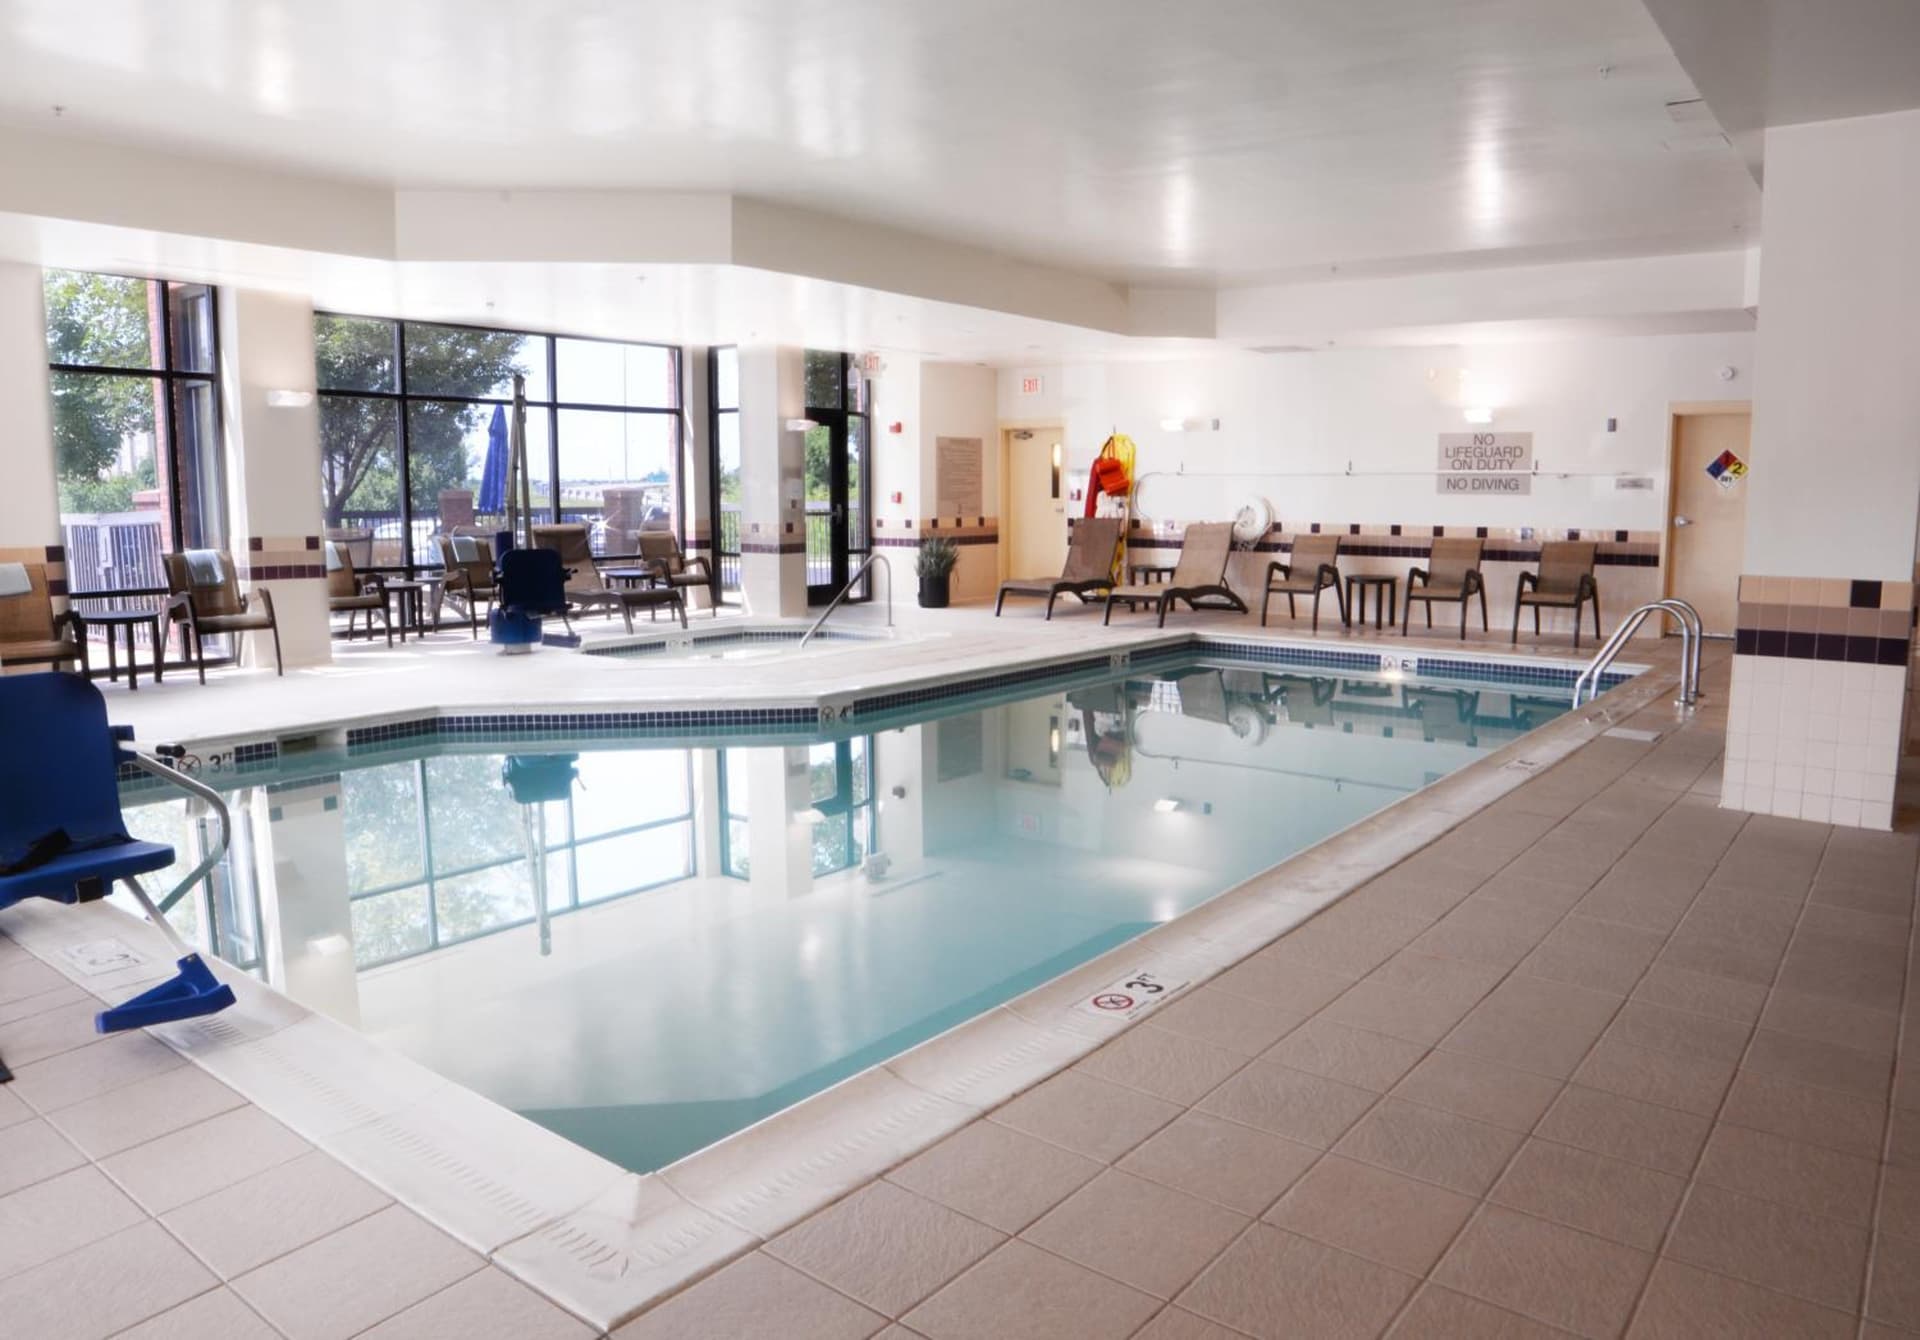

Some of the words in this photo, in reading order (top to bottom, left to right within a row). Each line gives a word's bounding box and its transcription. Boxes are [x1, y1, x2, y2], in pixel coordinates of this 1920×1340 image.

[1473, 433, 1495, 446] NO
[1445, 446, 1524, 458] LIFEGUARD
[1451, 459, 1473, 470] ON
[1477, 459, 1515, 470] DUTY
[1731, 457, 1743, 475] 2
[1447, 478, 1468, 490] NO
[1472, 478, 1521, 491] DIVING
